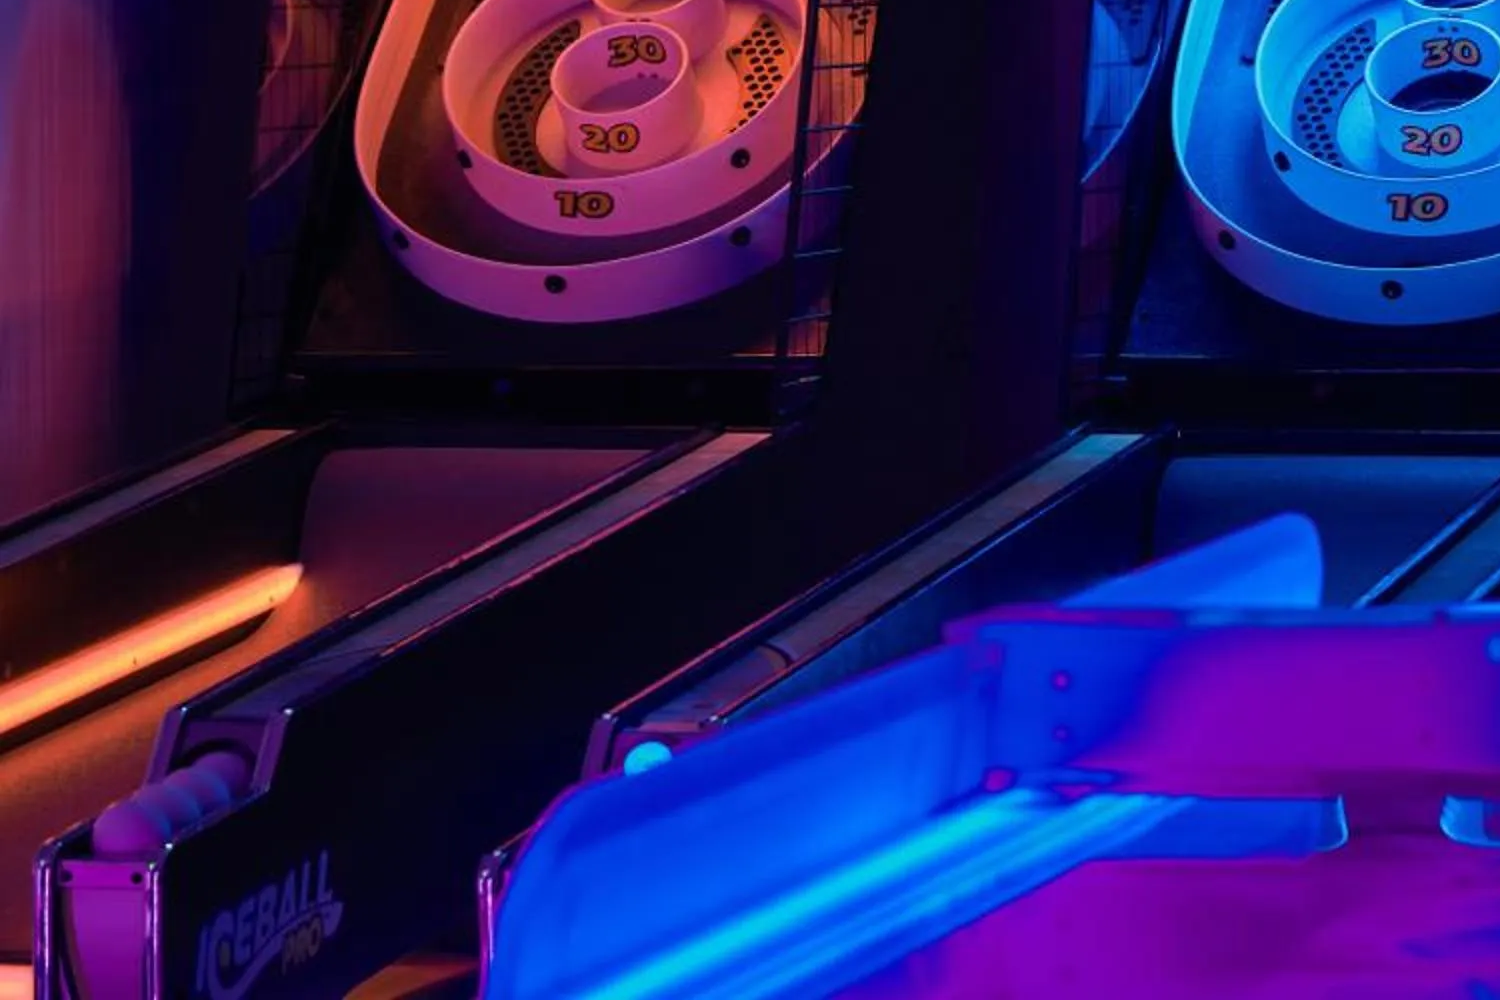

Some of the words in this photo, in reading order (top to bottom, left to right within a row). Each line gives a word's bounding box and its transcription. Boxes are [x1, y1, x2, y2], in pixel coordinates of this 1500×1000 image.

[607, 35, 667, 68] 30
[1422, 37, 1481, 69] 30
[579, 123, 640, 153] 20
[1401, 125, 1463, 156] 20
[553, 191, 614, 219] 10
[1387, 194, 1449, 221] 10
[196, 849, 344, 1000] ICEBALL
